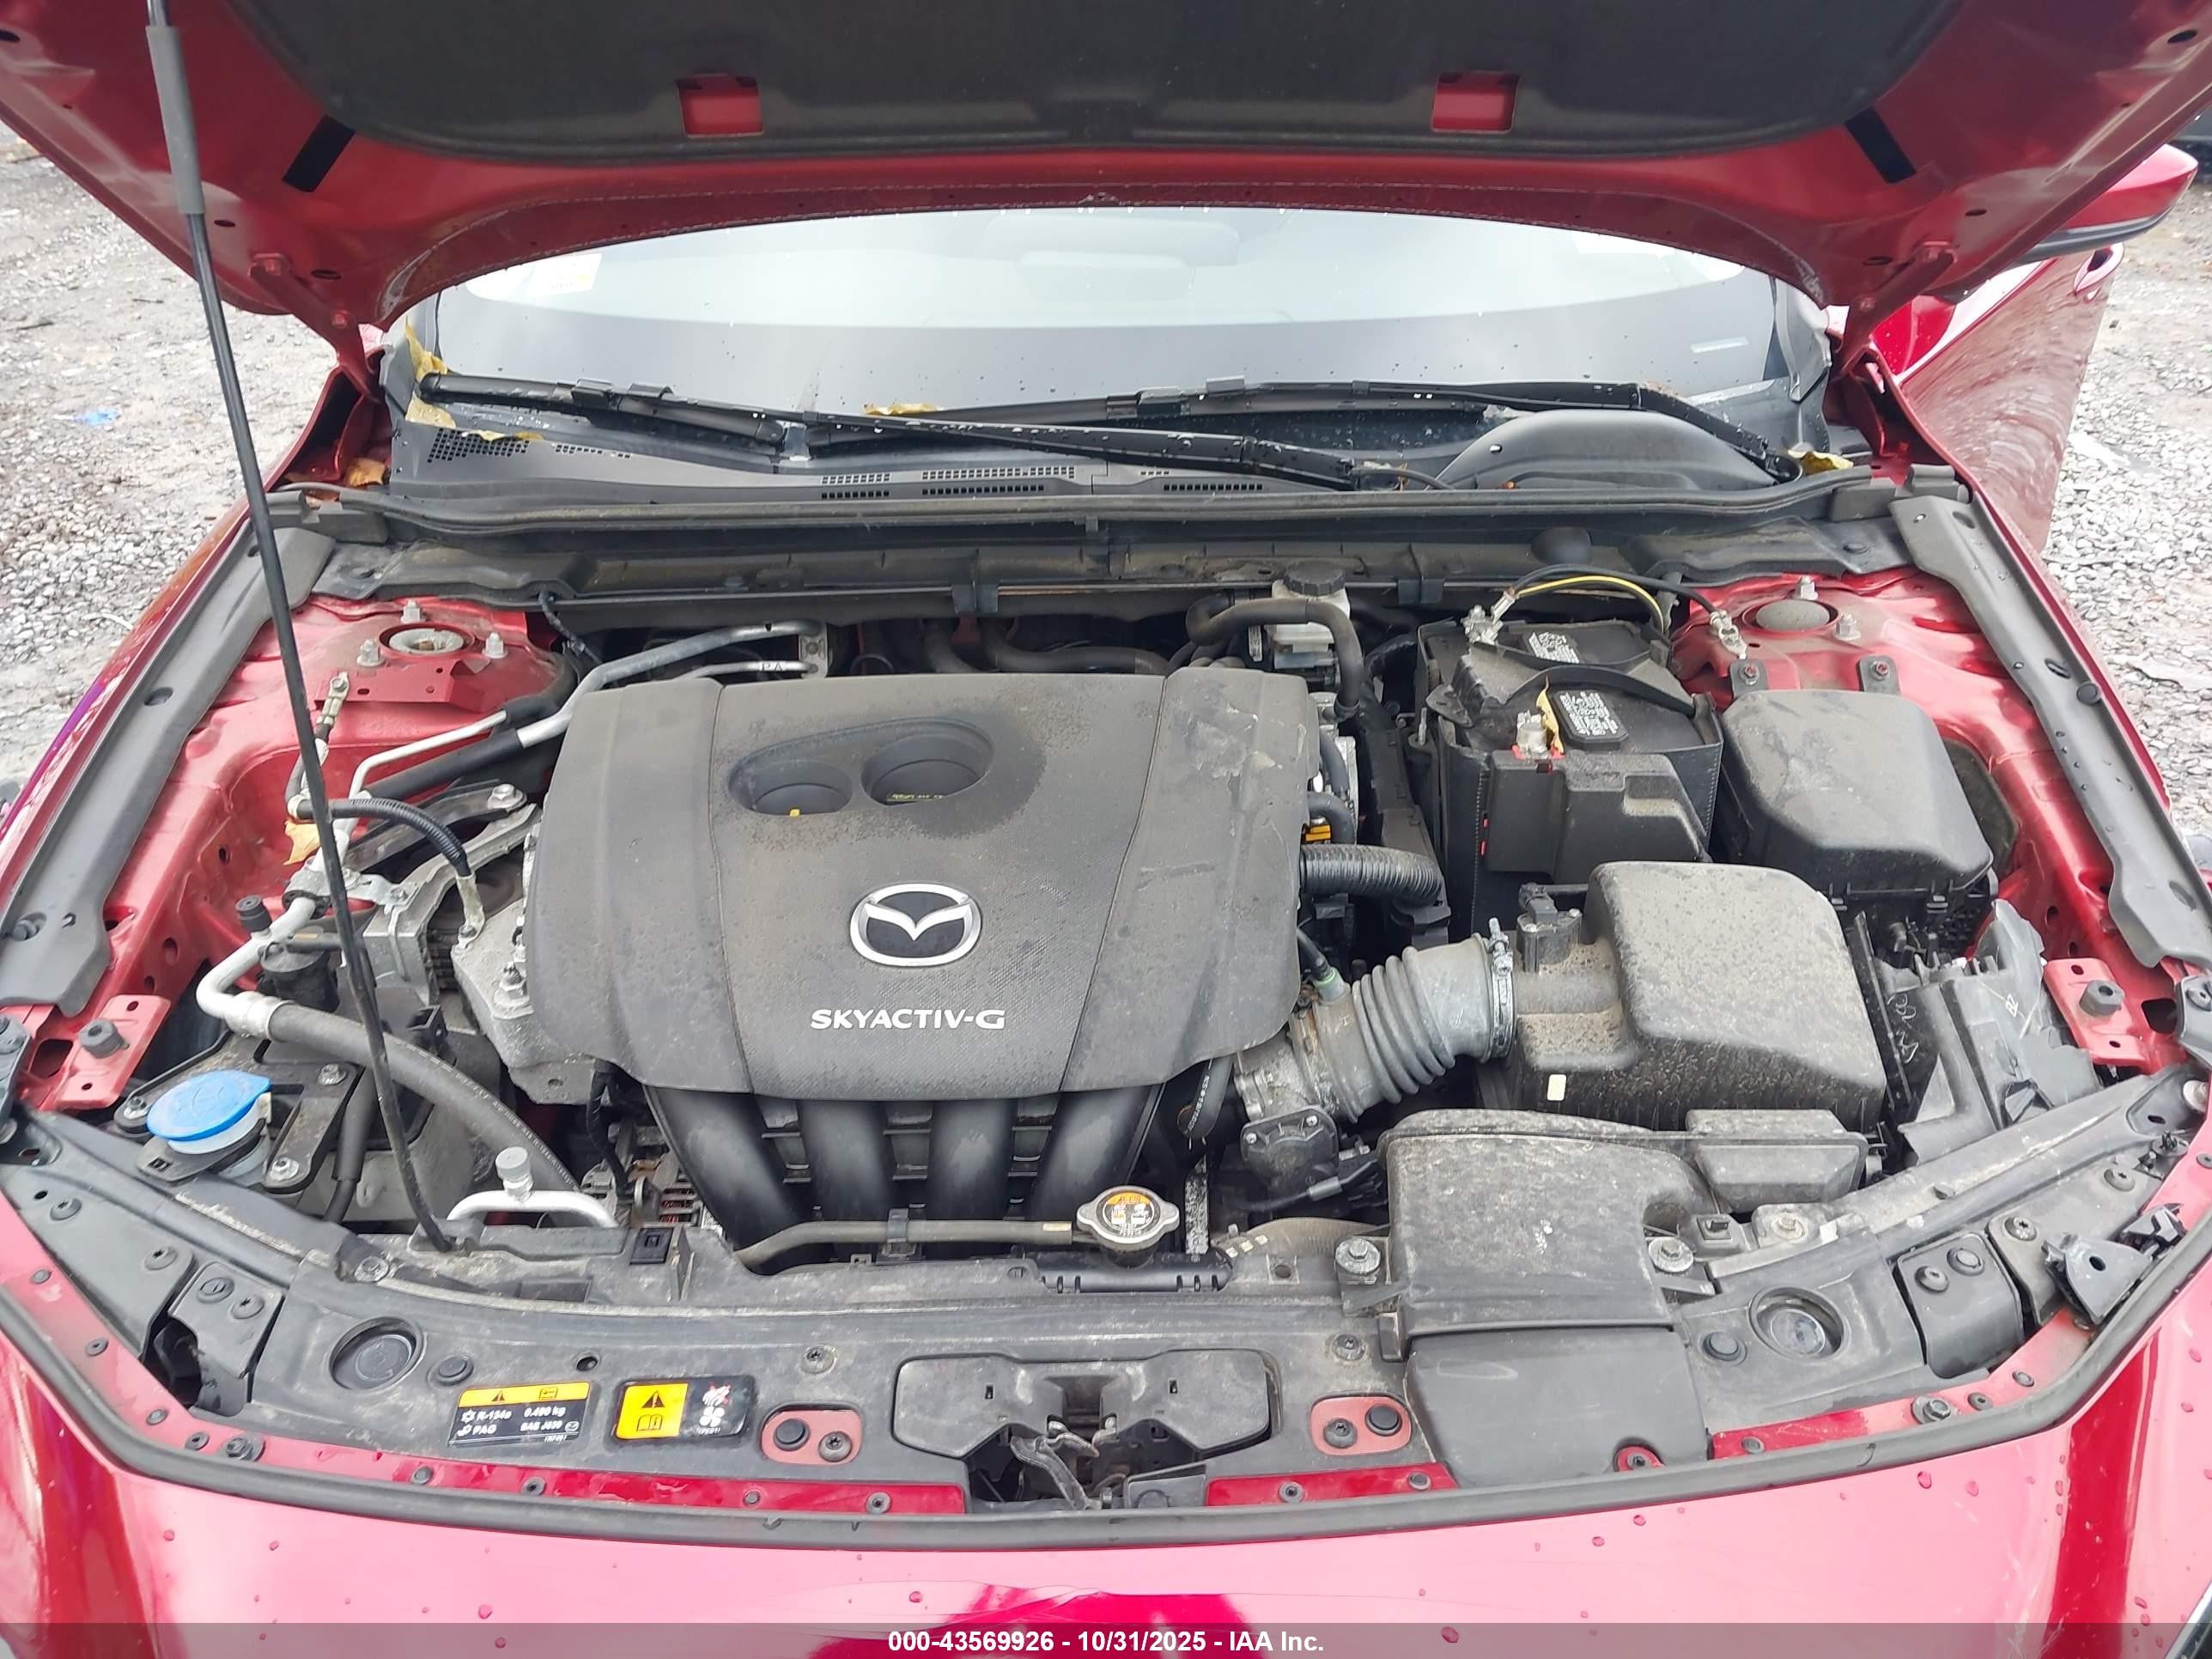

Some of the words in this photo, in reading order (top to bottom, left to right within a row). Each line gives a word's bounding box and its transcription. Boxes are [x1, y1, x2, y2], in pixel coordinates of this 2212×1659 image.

[810, 1009, 1006, 1030] SKYACTIV-G
[552, 1406, 566, 1417] kg
[472, 1424, 497, 1436] PAG
